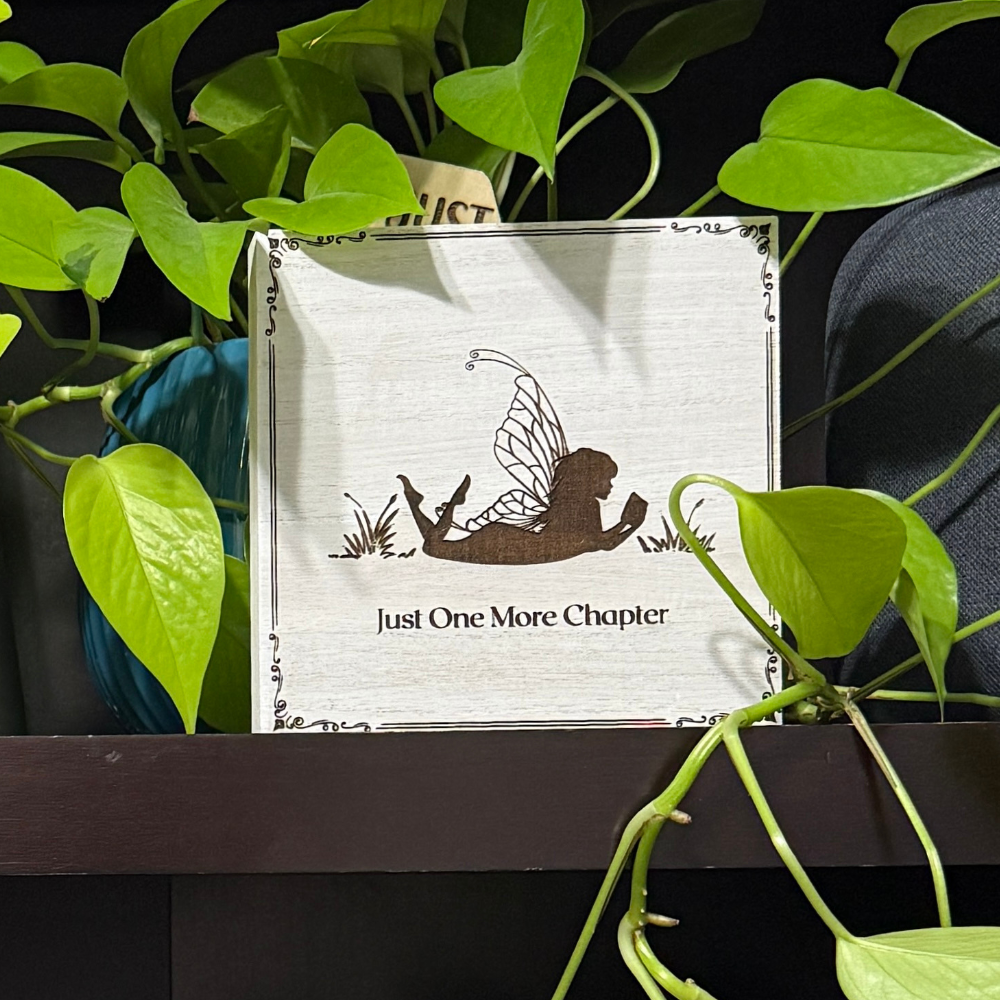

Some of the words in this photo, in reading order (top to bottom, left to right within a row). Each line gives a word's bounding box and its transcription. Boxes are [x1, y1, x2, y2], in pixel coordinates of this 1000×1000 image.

[377, 606, 422, 635] Just
[429, 606, 485, 629] One
[491, 605, 558, 628] More
[563, 603, 669, 631] Chapter
